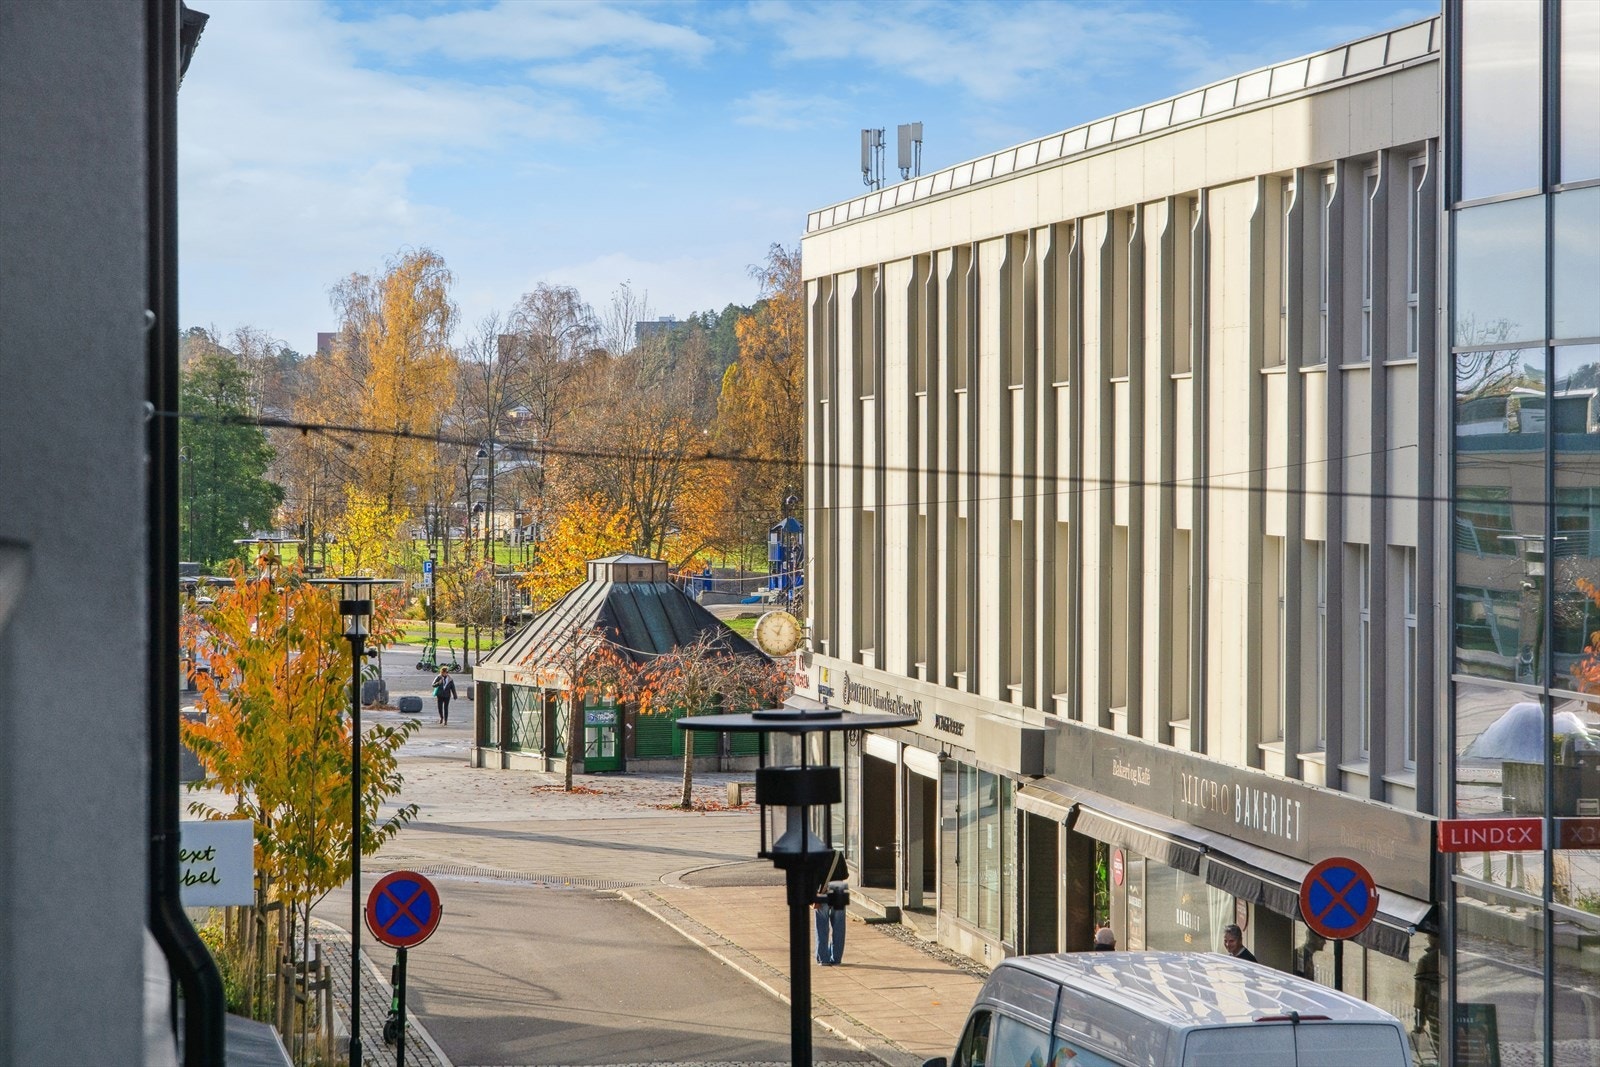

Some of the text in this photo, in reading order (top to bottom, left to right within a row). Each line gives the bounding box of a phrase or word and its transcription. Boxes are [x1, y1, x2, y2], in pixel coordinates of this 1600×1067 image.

[1112, 759, 1130, 780] Bakeri
[1181, 772, 1301, 842] MICRO BAKERIET
[1451, 826, 1533, 845] LINDEX
